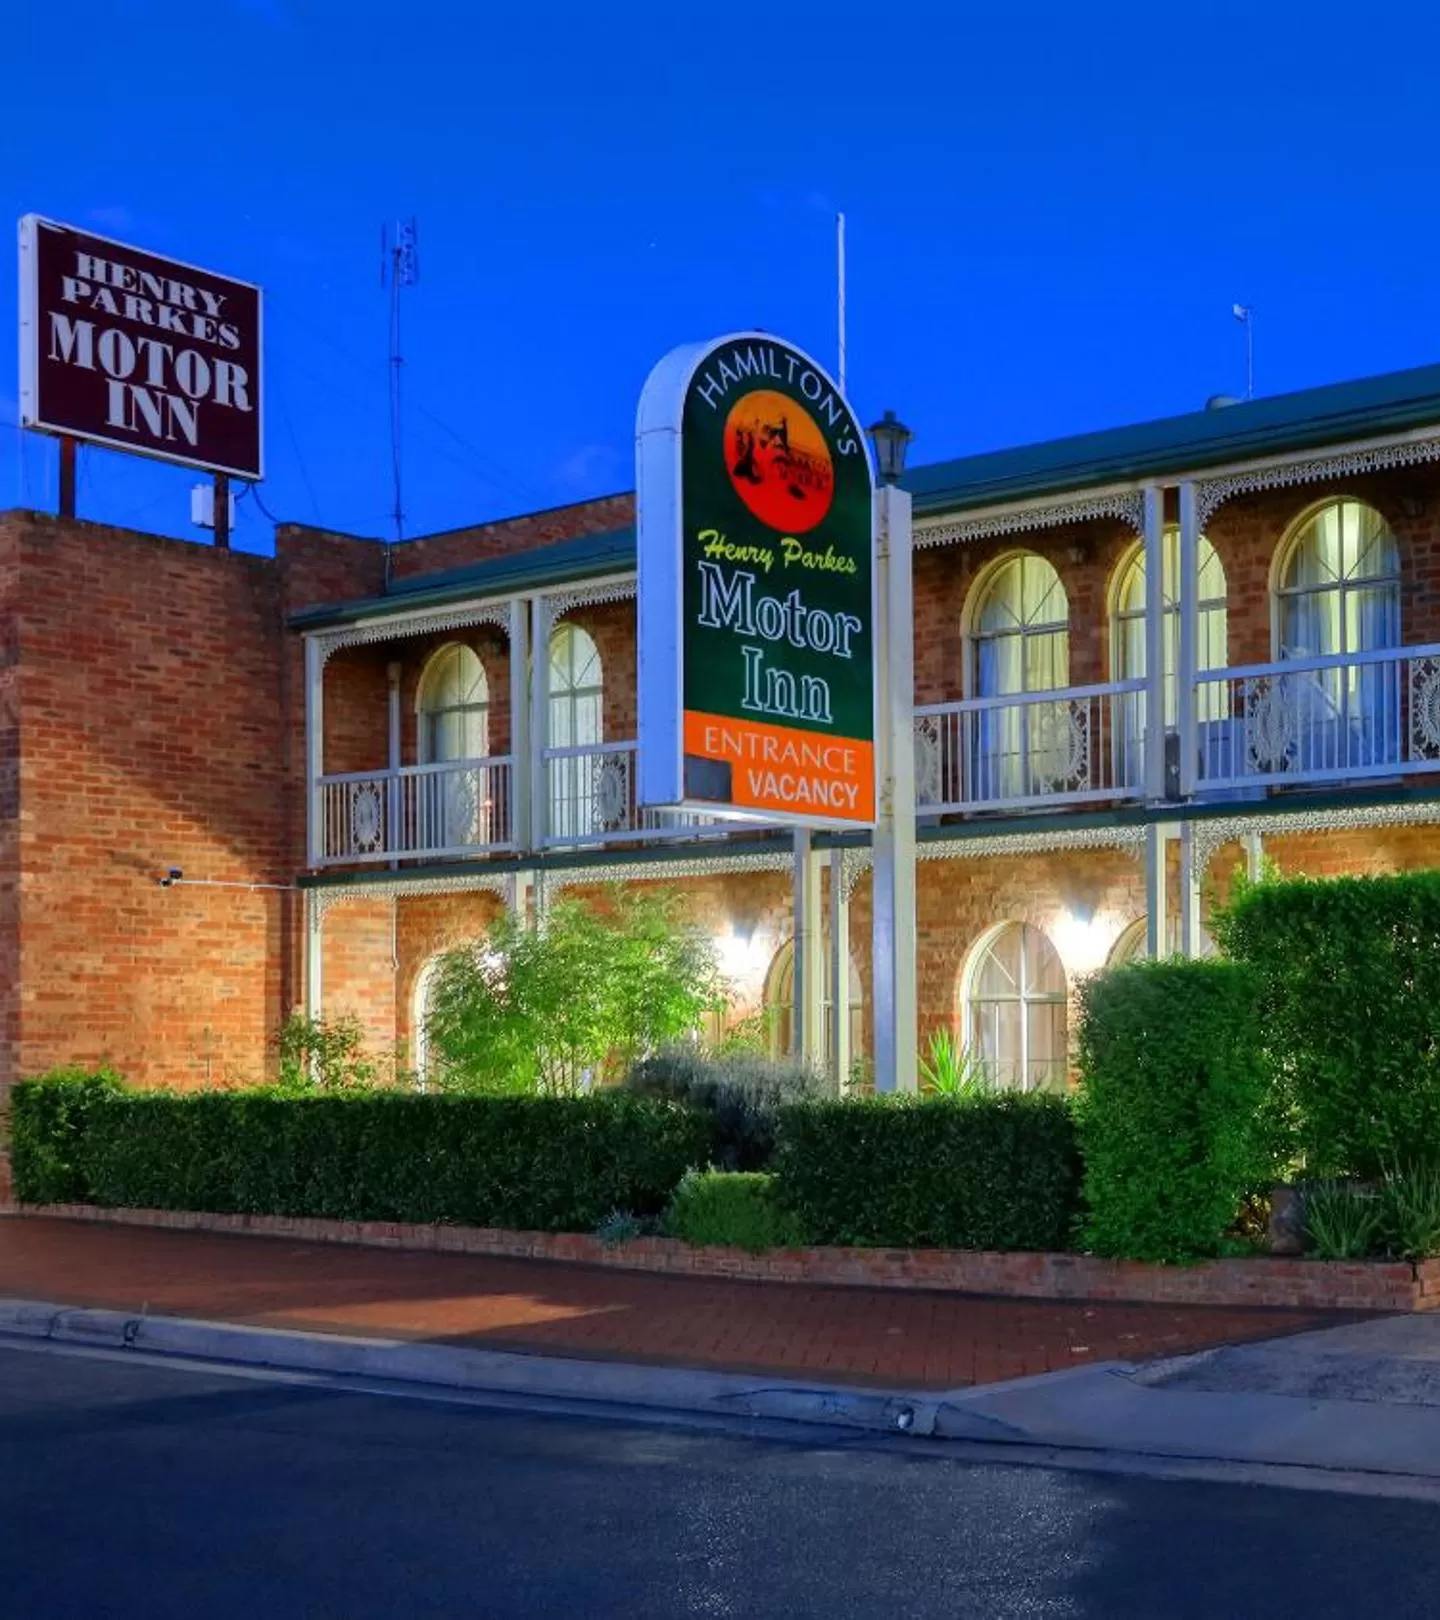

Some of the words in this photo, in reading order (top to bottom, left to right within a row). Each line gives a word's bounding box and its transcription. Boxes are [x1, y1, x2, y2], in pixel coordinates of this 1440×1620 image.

[61, 275, 240, 351] PARKES
[76, 251, 227, 317] HENRY
[48, 312, 253, 411] MOTOR
[106, 378, 200, 446] INN
[697, 346, 858, 457] HAMILTON'S
[698, 529, 774, 573] Henry
[780, 537, 857, 574] Parkes
[699, 561, 862, 657] Motor
[742, 647, 833, 723] Inn
[705, 727, 856, 775] ENTRANCE
[749, 770, 859, 809] VACANCY
